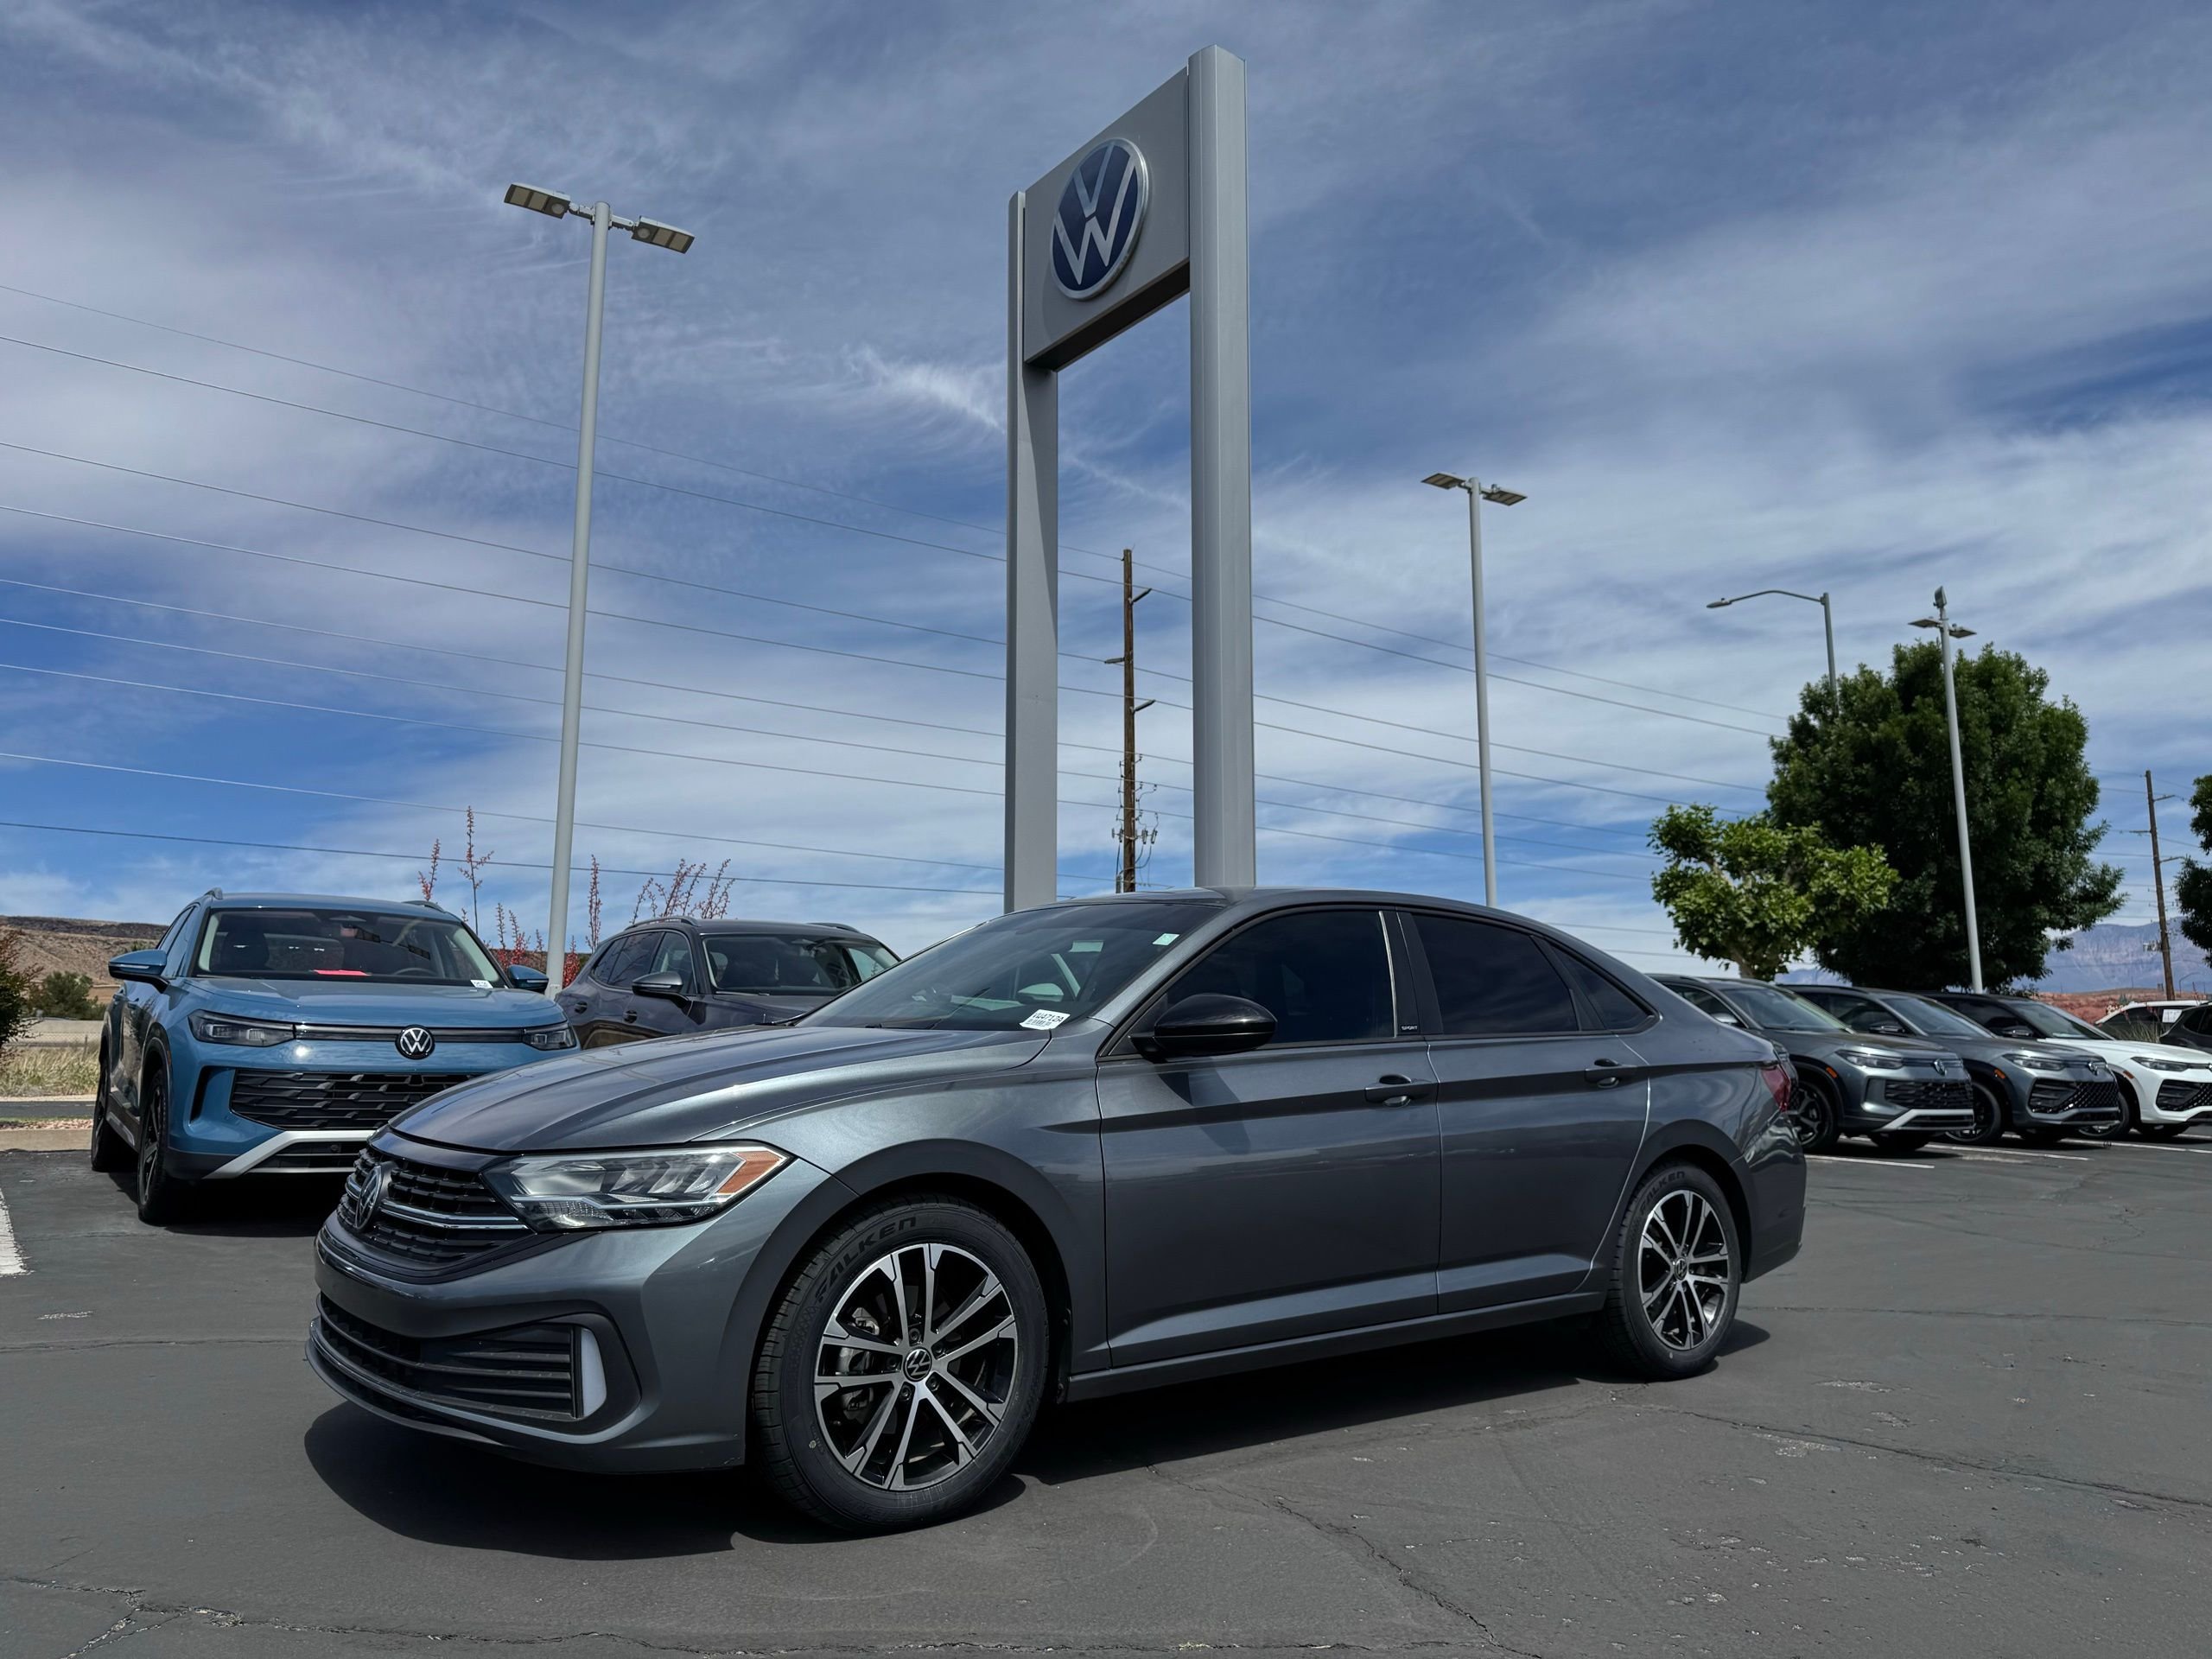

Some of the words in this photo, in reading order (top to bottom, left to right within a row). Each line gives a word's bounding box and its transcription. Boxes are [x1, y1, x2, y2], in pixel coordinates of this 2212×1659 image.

[1052, 139, 1144, 292] VW
[400, 1027, 433, 1054] VW
[815, 1216, 917, 1303] FALKEN
[905, 1348, 931, 1380] VW
